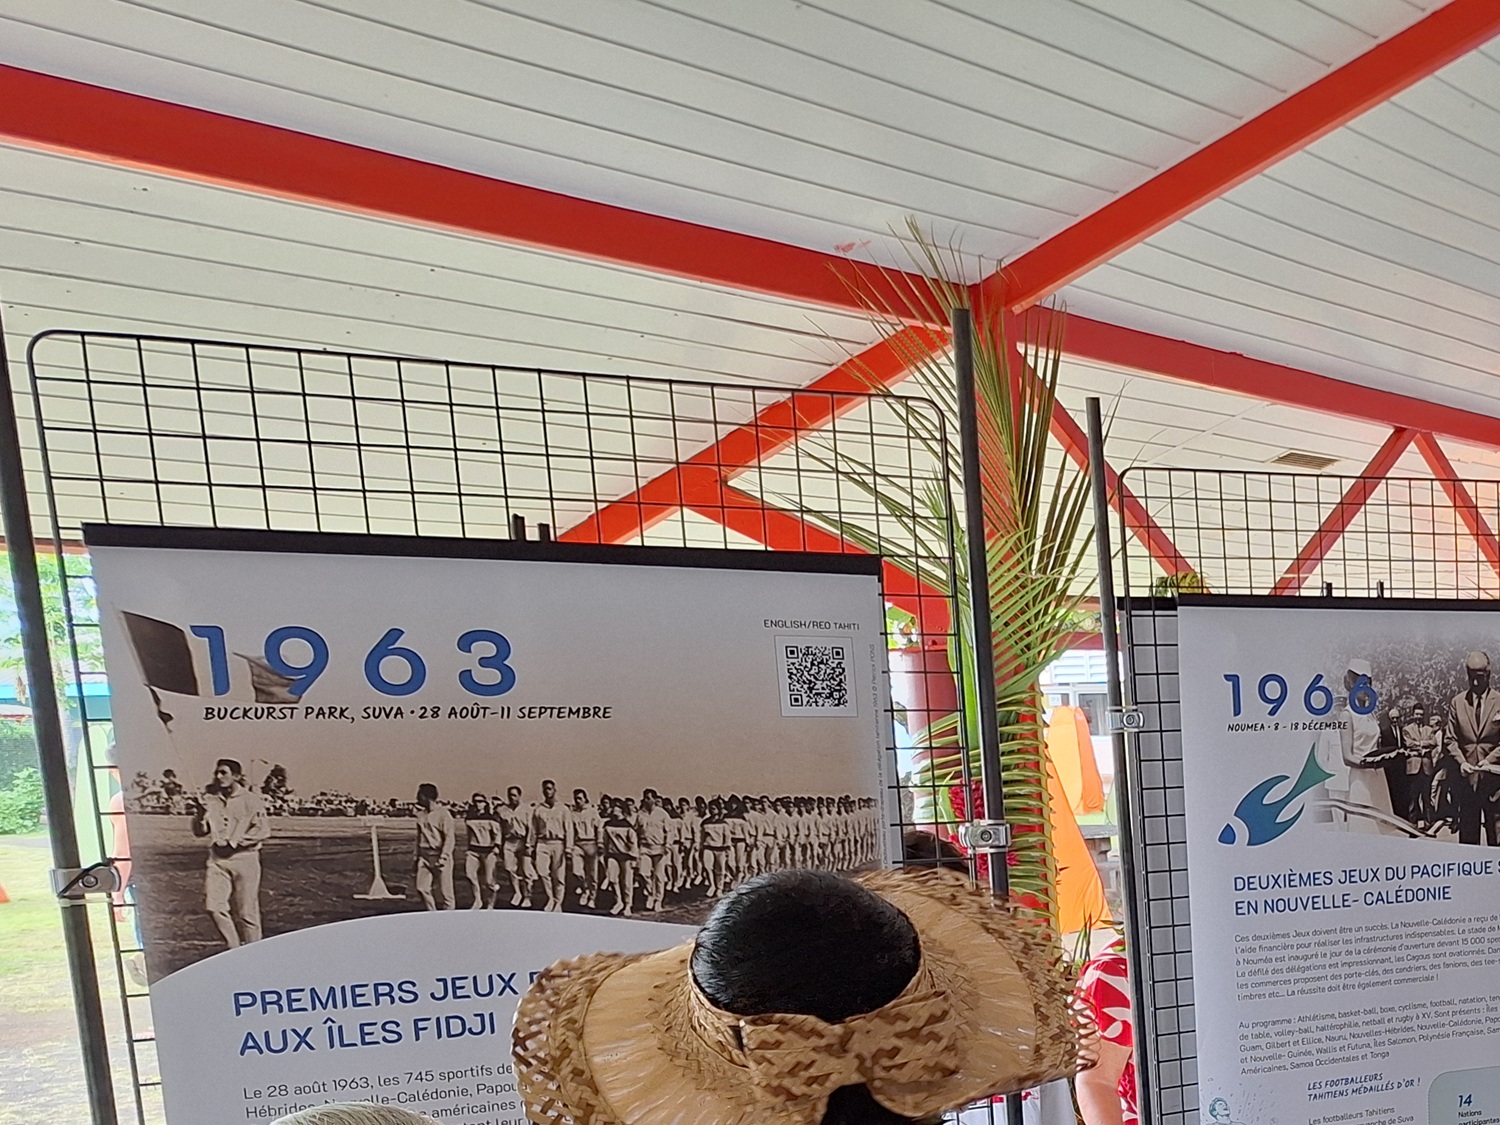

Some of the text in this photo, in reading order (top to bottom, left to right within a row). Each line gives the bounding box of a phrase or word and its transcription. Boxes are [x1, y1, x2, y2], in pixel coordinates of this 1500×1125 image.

[763, 619, 859, 631] ENGLISH/REO TAHITI
[189, 625, 516, 697] 1963
[1223, 673, 1377, 718] 1966
[202, 706, 300, 720] BUCKURST
[304, 706, 355, 723] PARK,
[361, 705, 404, 720] SUVA
[418, 705, 440, 719] 28
[516, 705, 612, 719] SEPTEMBRE
[1227, 722, 1265, 732] NOUMEA
[1290, 722, 1299, 731] 18
[1302, 719, 1348, 731] DÉCEMBRE
[1234, 868, 1333, 892] DEUXIÈMES
[1338, 867, 1380, 884] JEUX
[1386, 865, 1406, 881] DU
[1411, 860, 1493, 879] PACIFIQUE
[1235, 885, 1452, 916] EN NOUVELLE- CALÉDONIE
[1235, 934, 1249, 943] Ces
[1252, 930, 1290, 942] deuxièmes
[1292, 930, 1310, 938] Jeux
[1312, 926, 1338, 937] doivent
[1339, 925, 1353, 934] être
[1365, 922, 1389, 932] succès.
[1391, 922, 1399, 930] La
[1400, 916, 1466, 929] Nouvelle-Calédonie
[1474, 915, 1488, 924] reçu
[233, 979, 419, 1017] PREMIERS
[429, 972, 519, 1001] JEUX
[239, 1012, 496, 1056] AUX ÎLES FIDJI
[244, 1087, 262, 1100] Le
[266, 1084, 289, 1098] 28
[293, 1080, 328, 1096] août
[332, 1076, 374, 1092] 1963,
[378, 1073, 401, 1087] les
[404, 1070, 434, 1084] 745
[439, 1064, 493, 1083] sportifs
[1307, 1073, 1383, 1091] LES FOOTBALLEURS
[1308, 1078, 1414, 1101] TAHITIENS MÉDAILLÉS D'OR
[432, 1100, 516, 1118] américaines
[1458, 1094, 1472, 1107] 14
[1309, 1107, 1395, 1125] Les footballeurs Tahitiens
[1458, 1110, 1482, 1118] Nations
